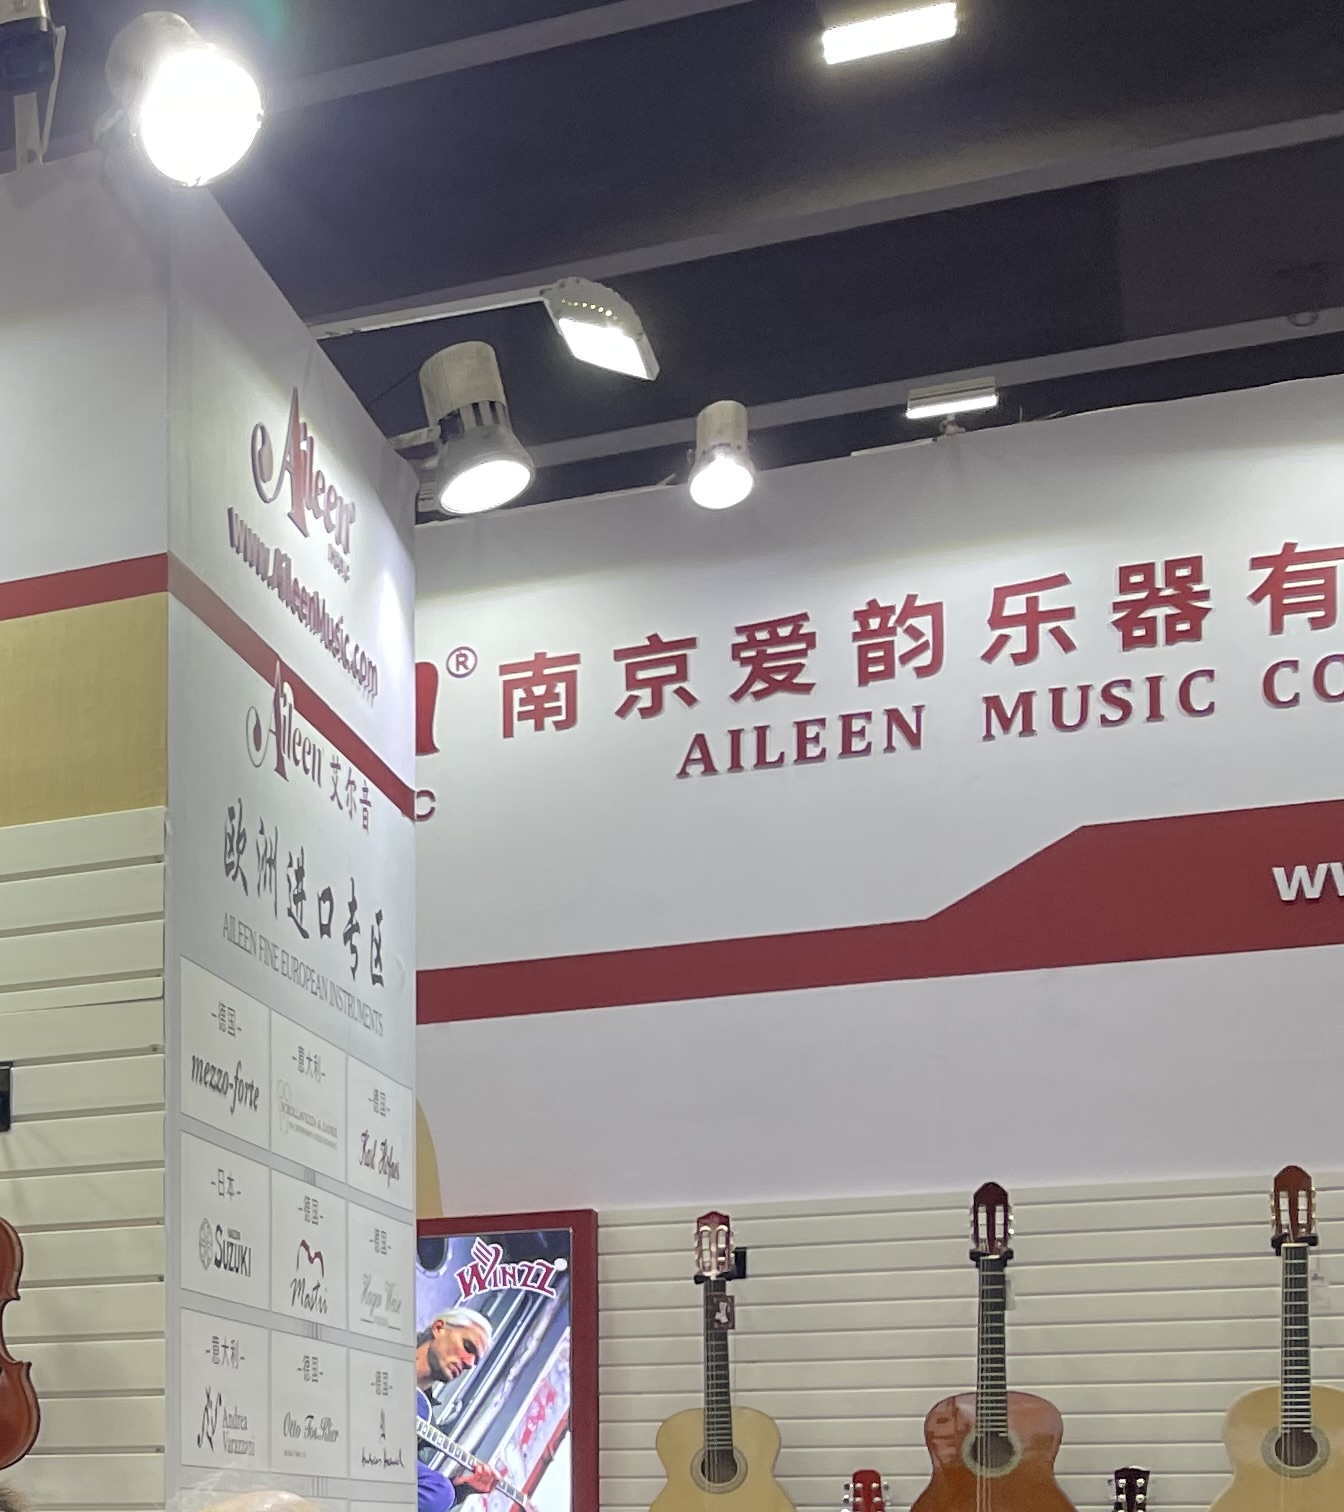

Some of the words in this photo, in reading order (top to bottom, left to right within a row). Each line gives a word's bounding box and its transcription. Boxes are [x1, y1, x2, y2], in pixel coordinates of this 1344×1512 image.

[498, 541, 1344, 740] 南京爱韵乐器有
[246, 660, 322, 788] Aileen
[676, 704, 927, 780] AILEEN
[981, 668, 1217, 742] MUSIC
[330, 754, 372, 835] 艾尔音
[223, 797, 385, 988] 欧洲进口专区
[191, 1054, 260, 1116] mezzo-forte
